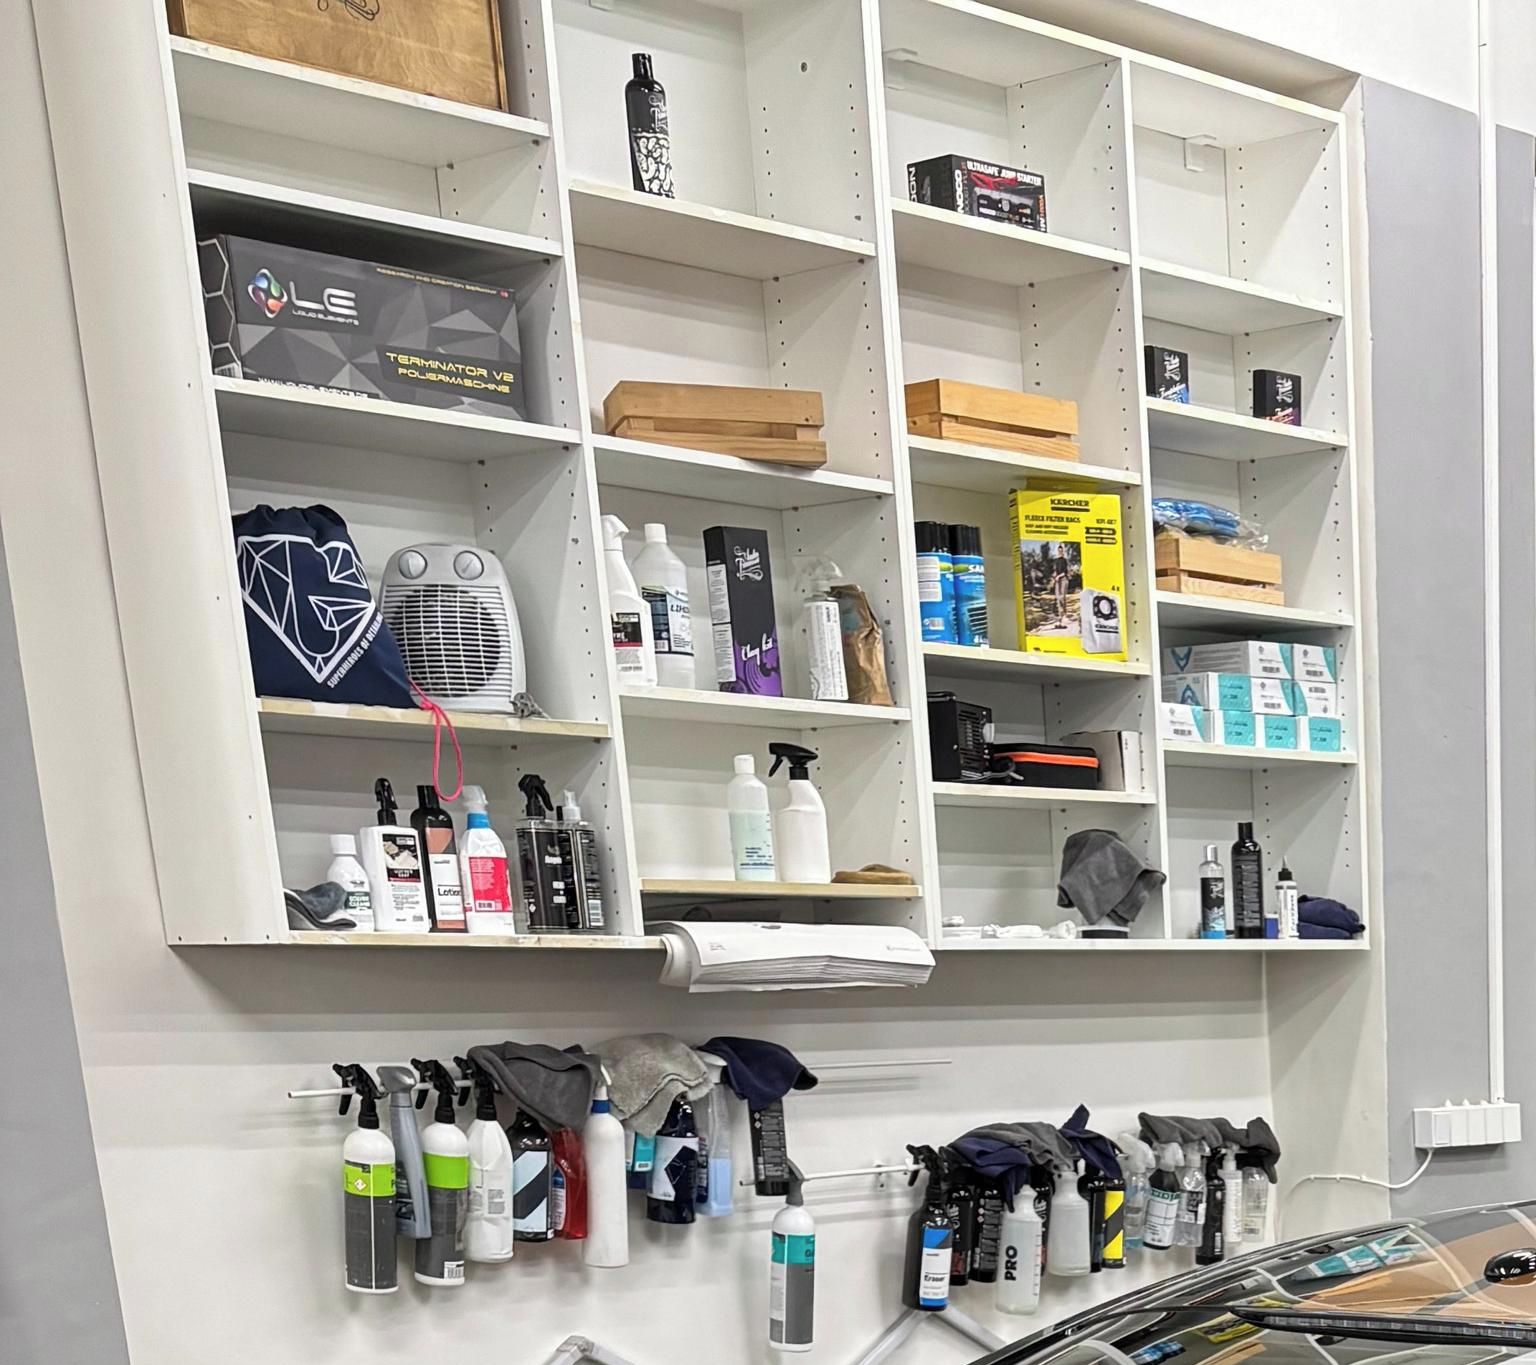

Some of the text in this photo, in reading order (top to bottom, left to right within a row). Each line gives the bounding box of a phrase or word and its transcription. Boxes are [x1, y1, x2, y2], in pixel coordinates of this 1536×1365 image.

[385, 351, 515, 383] TERMINATOR V2
[397, 367, 511, 394] POLIERMASCHINE
[1004, 1245, 1018, 1281] PRO
